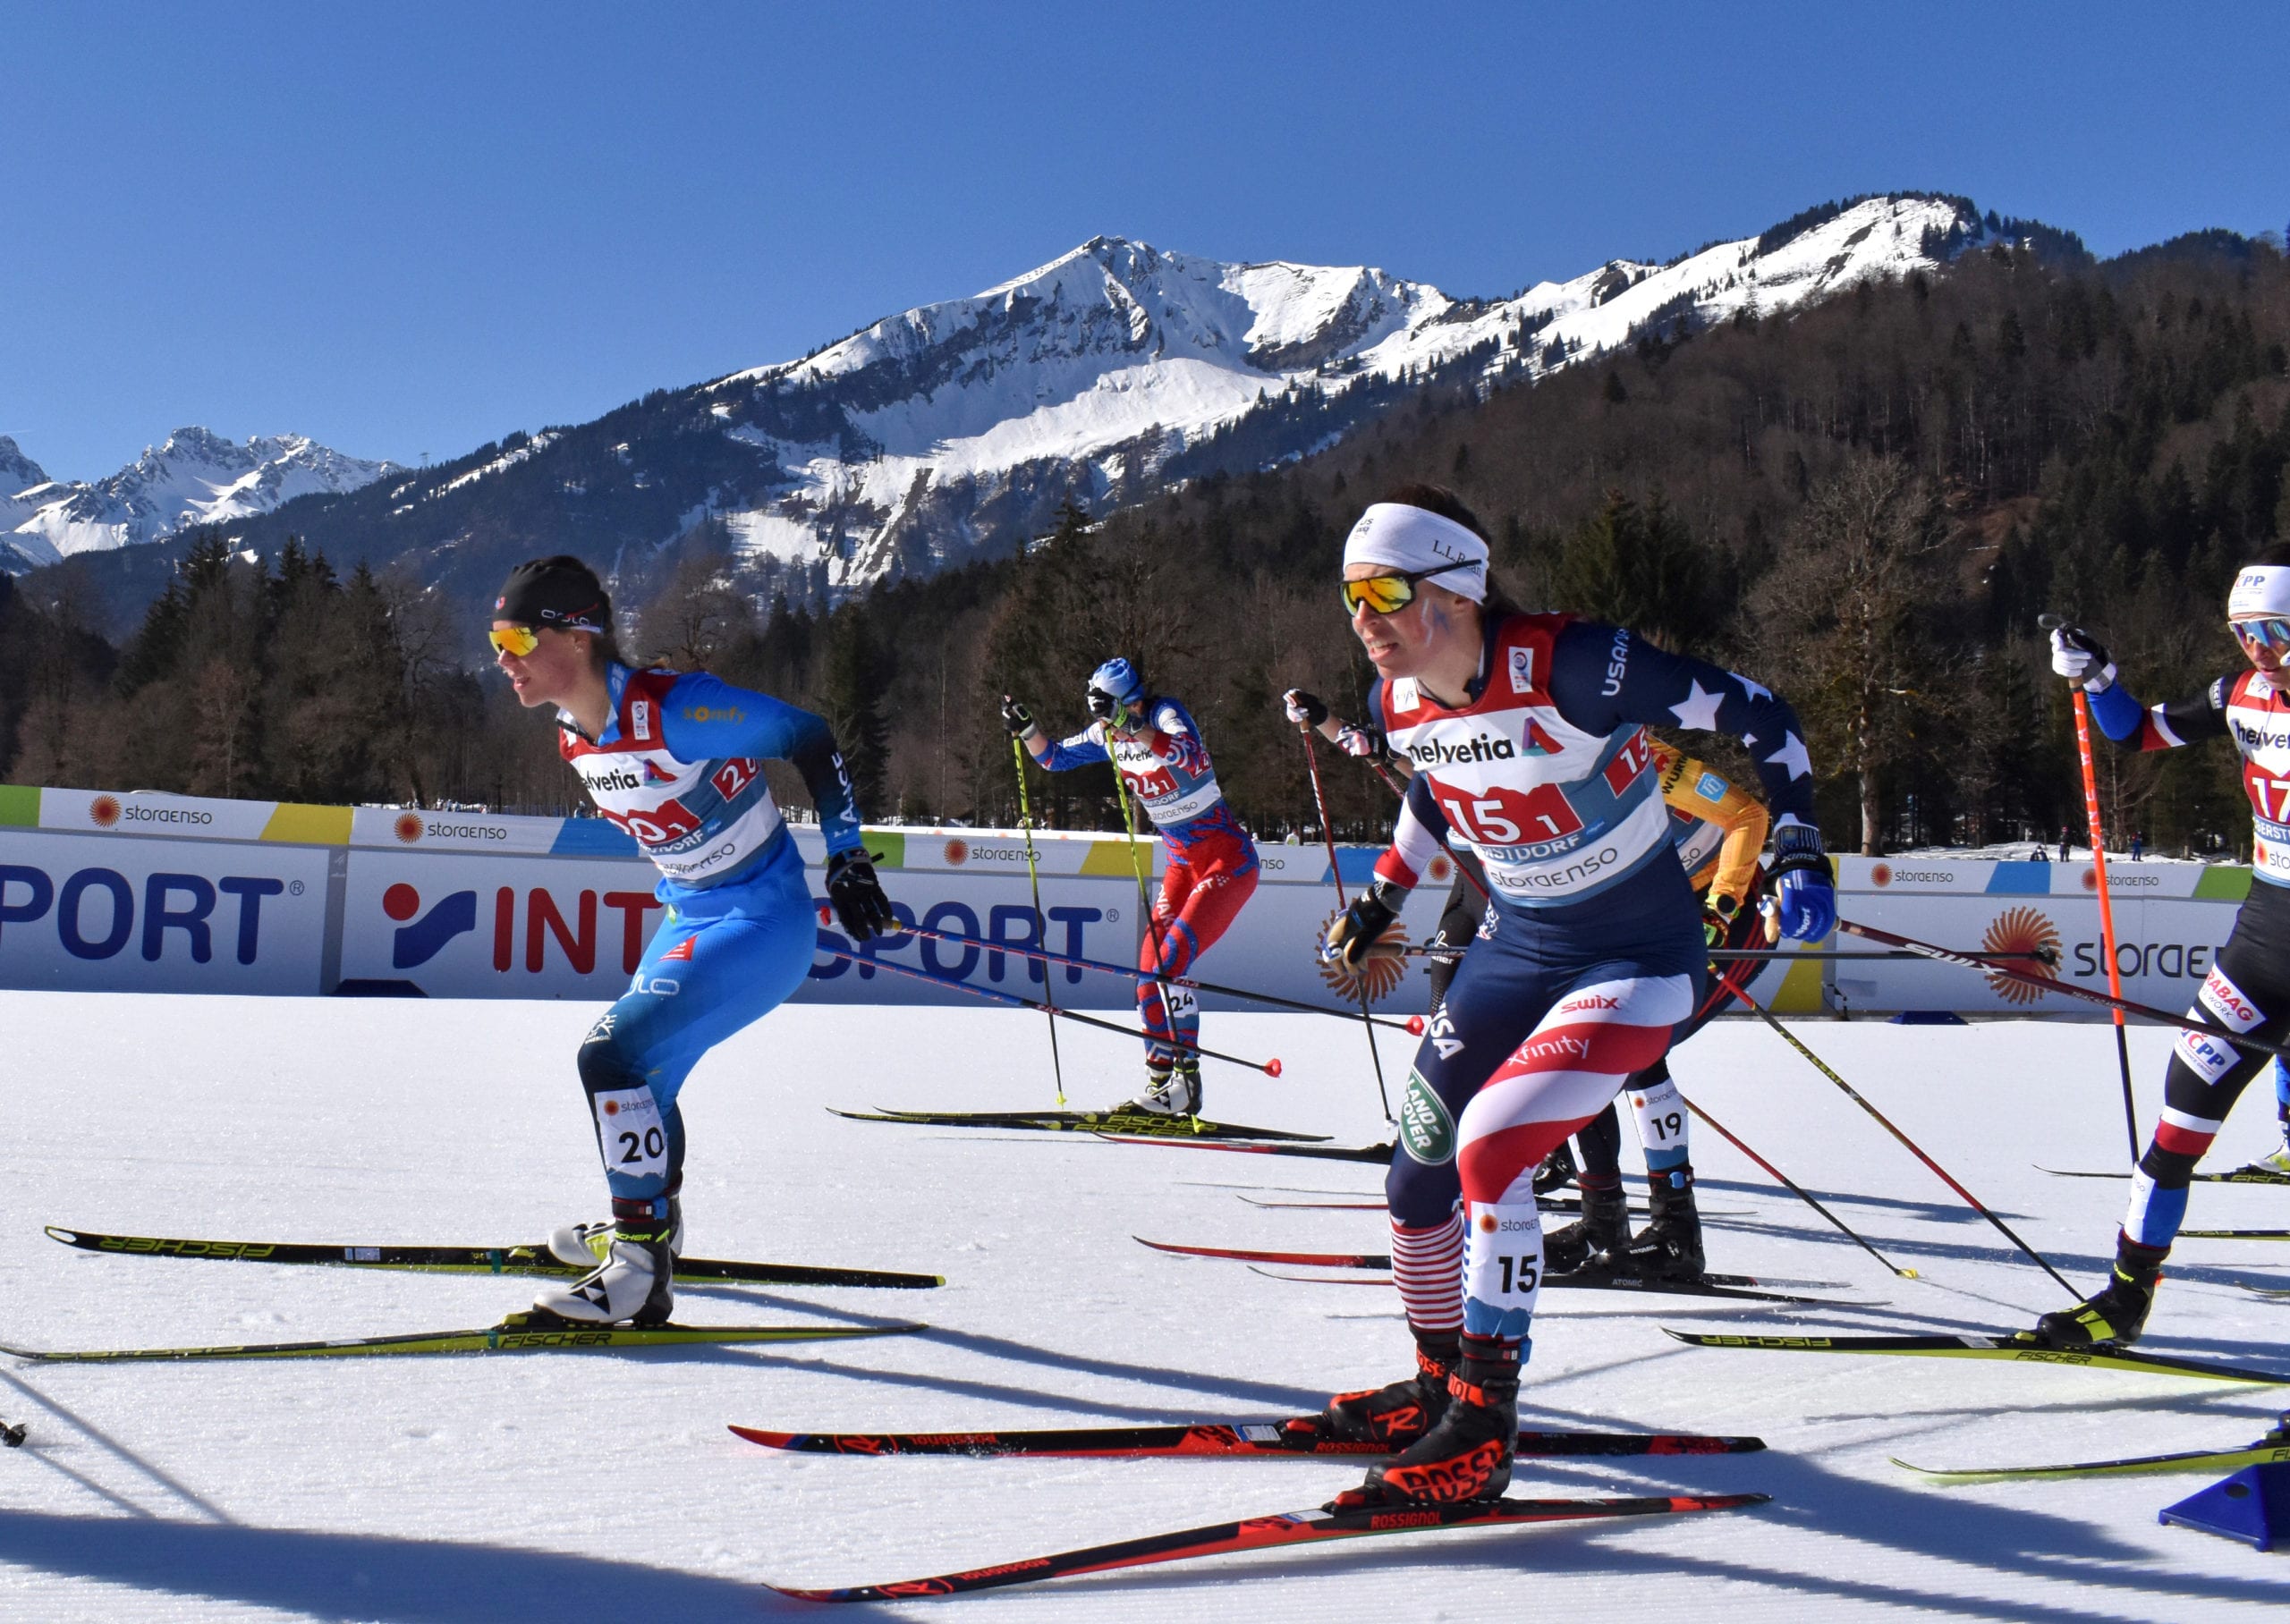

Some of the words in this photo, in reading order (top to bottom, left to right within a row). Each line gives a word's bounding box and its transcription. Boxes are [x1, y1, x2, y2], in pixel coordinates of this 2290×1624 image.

[683, 706, 747, 726] somfy
[2252, 776, 2290, 823] 17
[124, 807, 213, 825] storaenso
[1443, 799, 1522, 843] 15
[1535, 814, 1561, 835] 1
[427, 822, 507, 841] storaenso
[1491, 847, 1618, 888] storaenso
[1894, 870, 1954, 884] storaenso
[2106, 875, 2159, 886] storaenso
[1170, 992, 1195, 1012] 24
[1507, 1035, 1592, 1068] xfinity
[1408, 1078, 1438, 1125] LAND
[1650, 1112, 1682, 1141] 19
[618, 1127, 665, 1163] 20
[98, 1235, 276, 1258] FISCHER
[1497, 1254, 1538, 1294] 15
[501, 1332, 612, 1349] FISCHER
[1701, 1335, 1832, 1349] FISCHER
[2014, 1350, 2091, 1366] FISCHER
[1370, 1511, 1443, 1530] ROSSIGNOL
